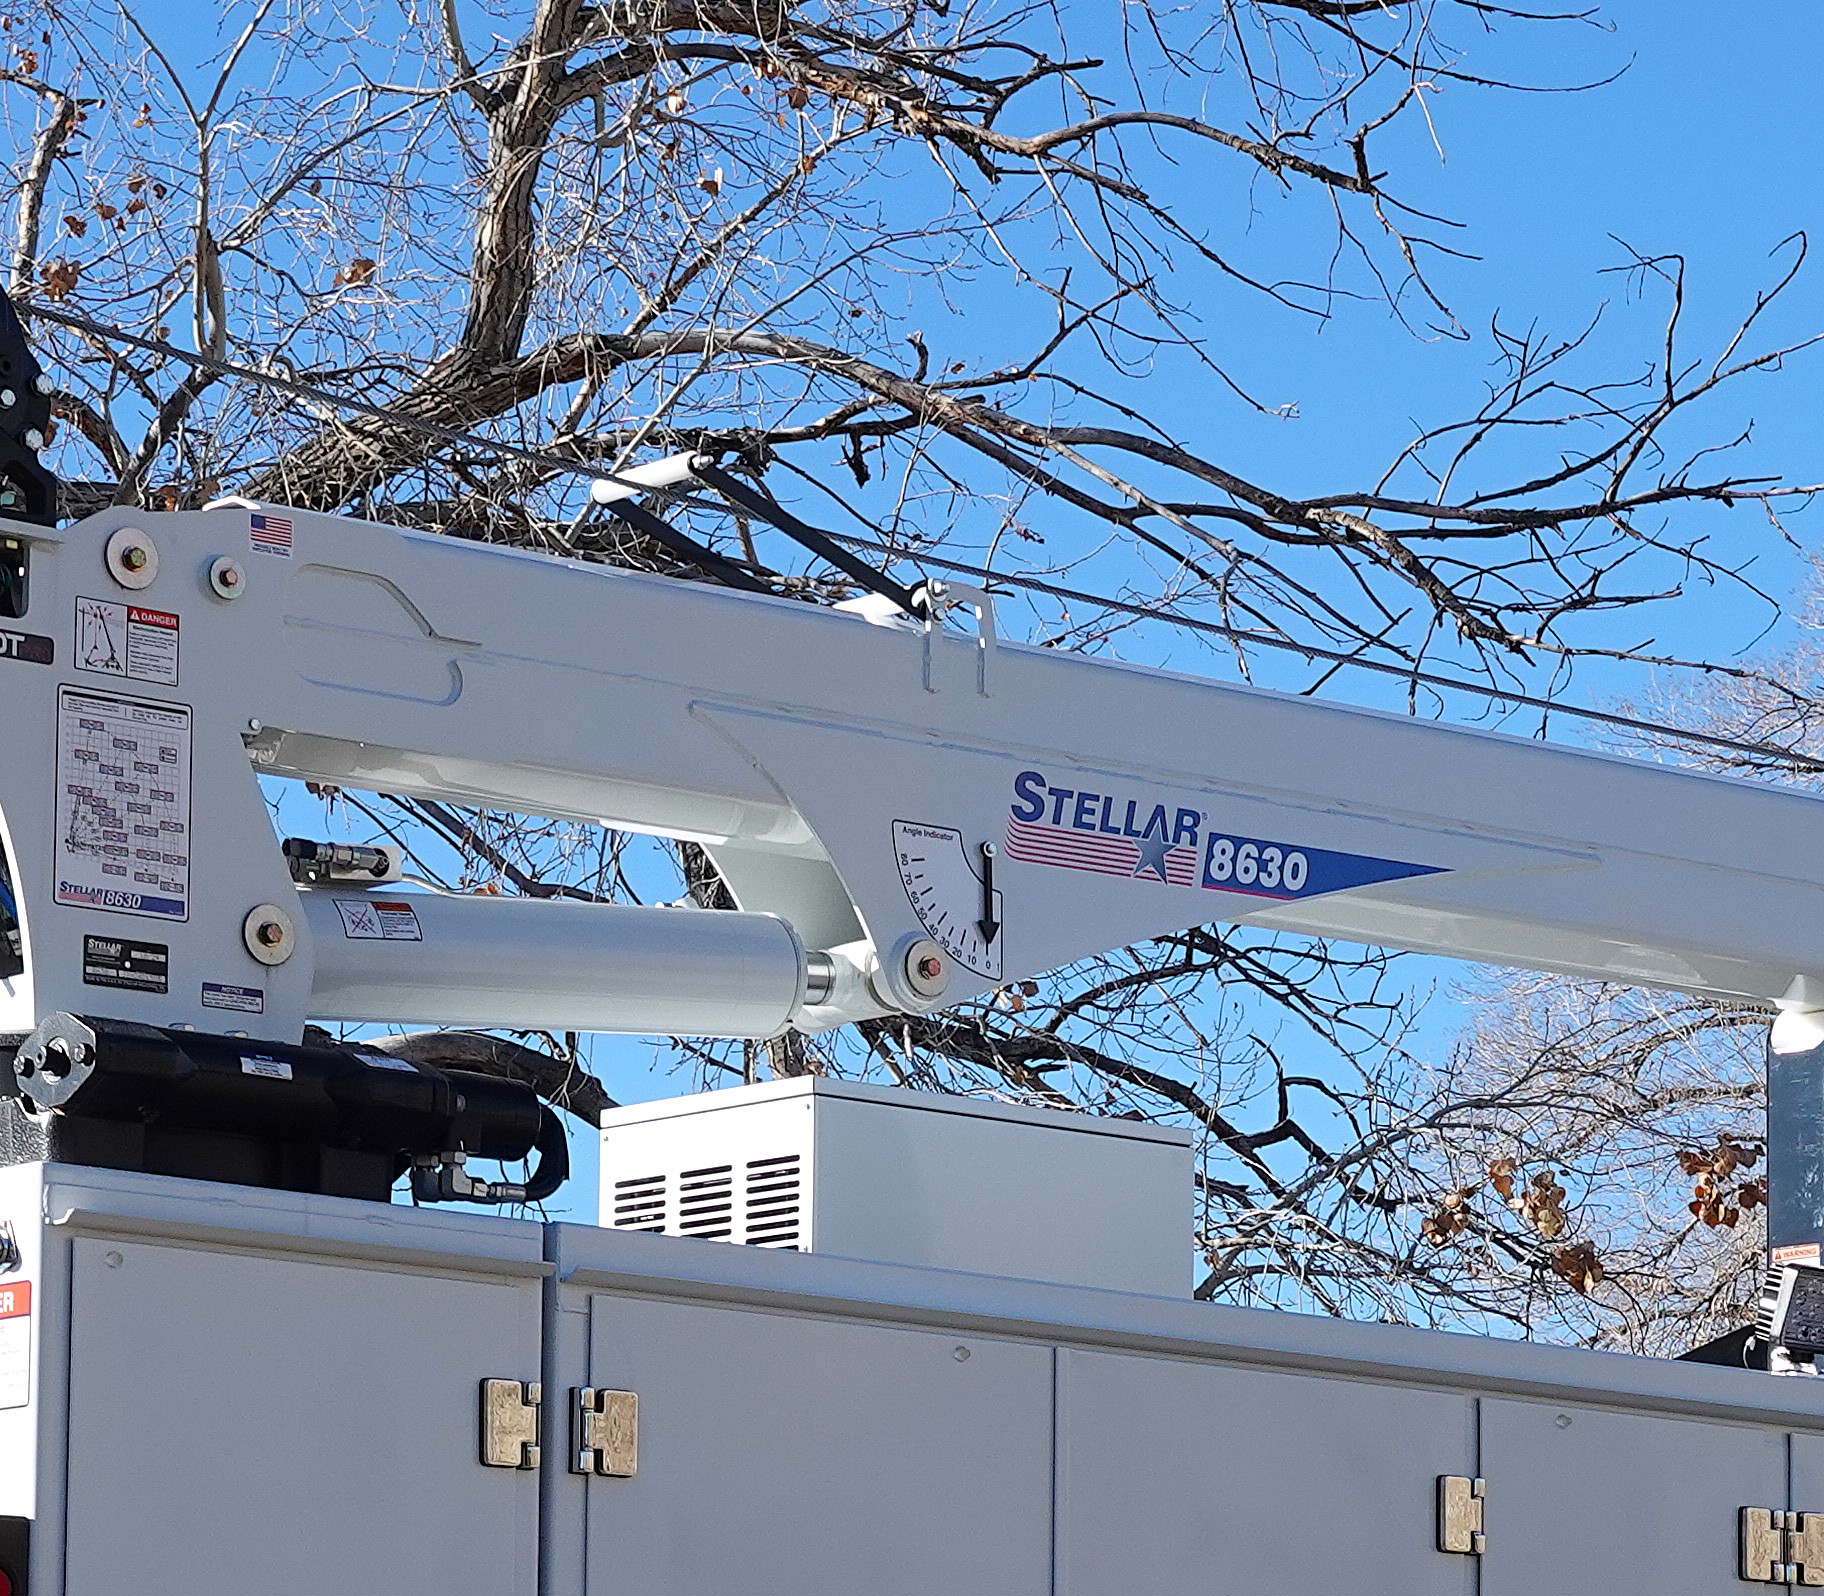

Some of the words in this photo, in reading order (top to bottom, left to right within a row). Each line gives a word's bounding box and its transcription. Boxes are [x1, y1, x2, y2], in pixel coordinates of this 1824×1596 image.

[141, 611, 178, 627] DANGER
[902, 825, 922, 838] Angle
[923, 829, 954, 841] Indicator
[1011, 770, 1202, 847] STELLAR
[1209, 838, 1309, 891] 8630
[900, 852, 909, 866] 80
[904, 871, 913, 886] 70
[60, 880, 104, 897] STELLAR
[105, 890, 142, 909] 8630
[910, 890, 920, 905] 60
[917, 907, 928, 920] 50
[928, 923, 939, 936] 40
[939, 936, 950, 949] 30
[952, 946, 963, 958] 20
[967, 954, 977, 966] 10
[985, 960, 992, 970] 0
